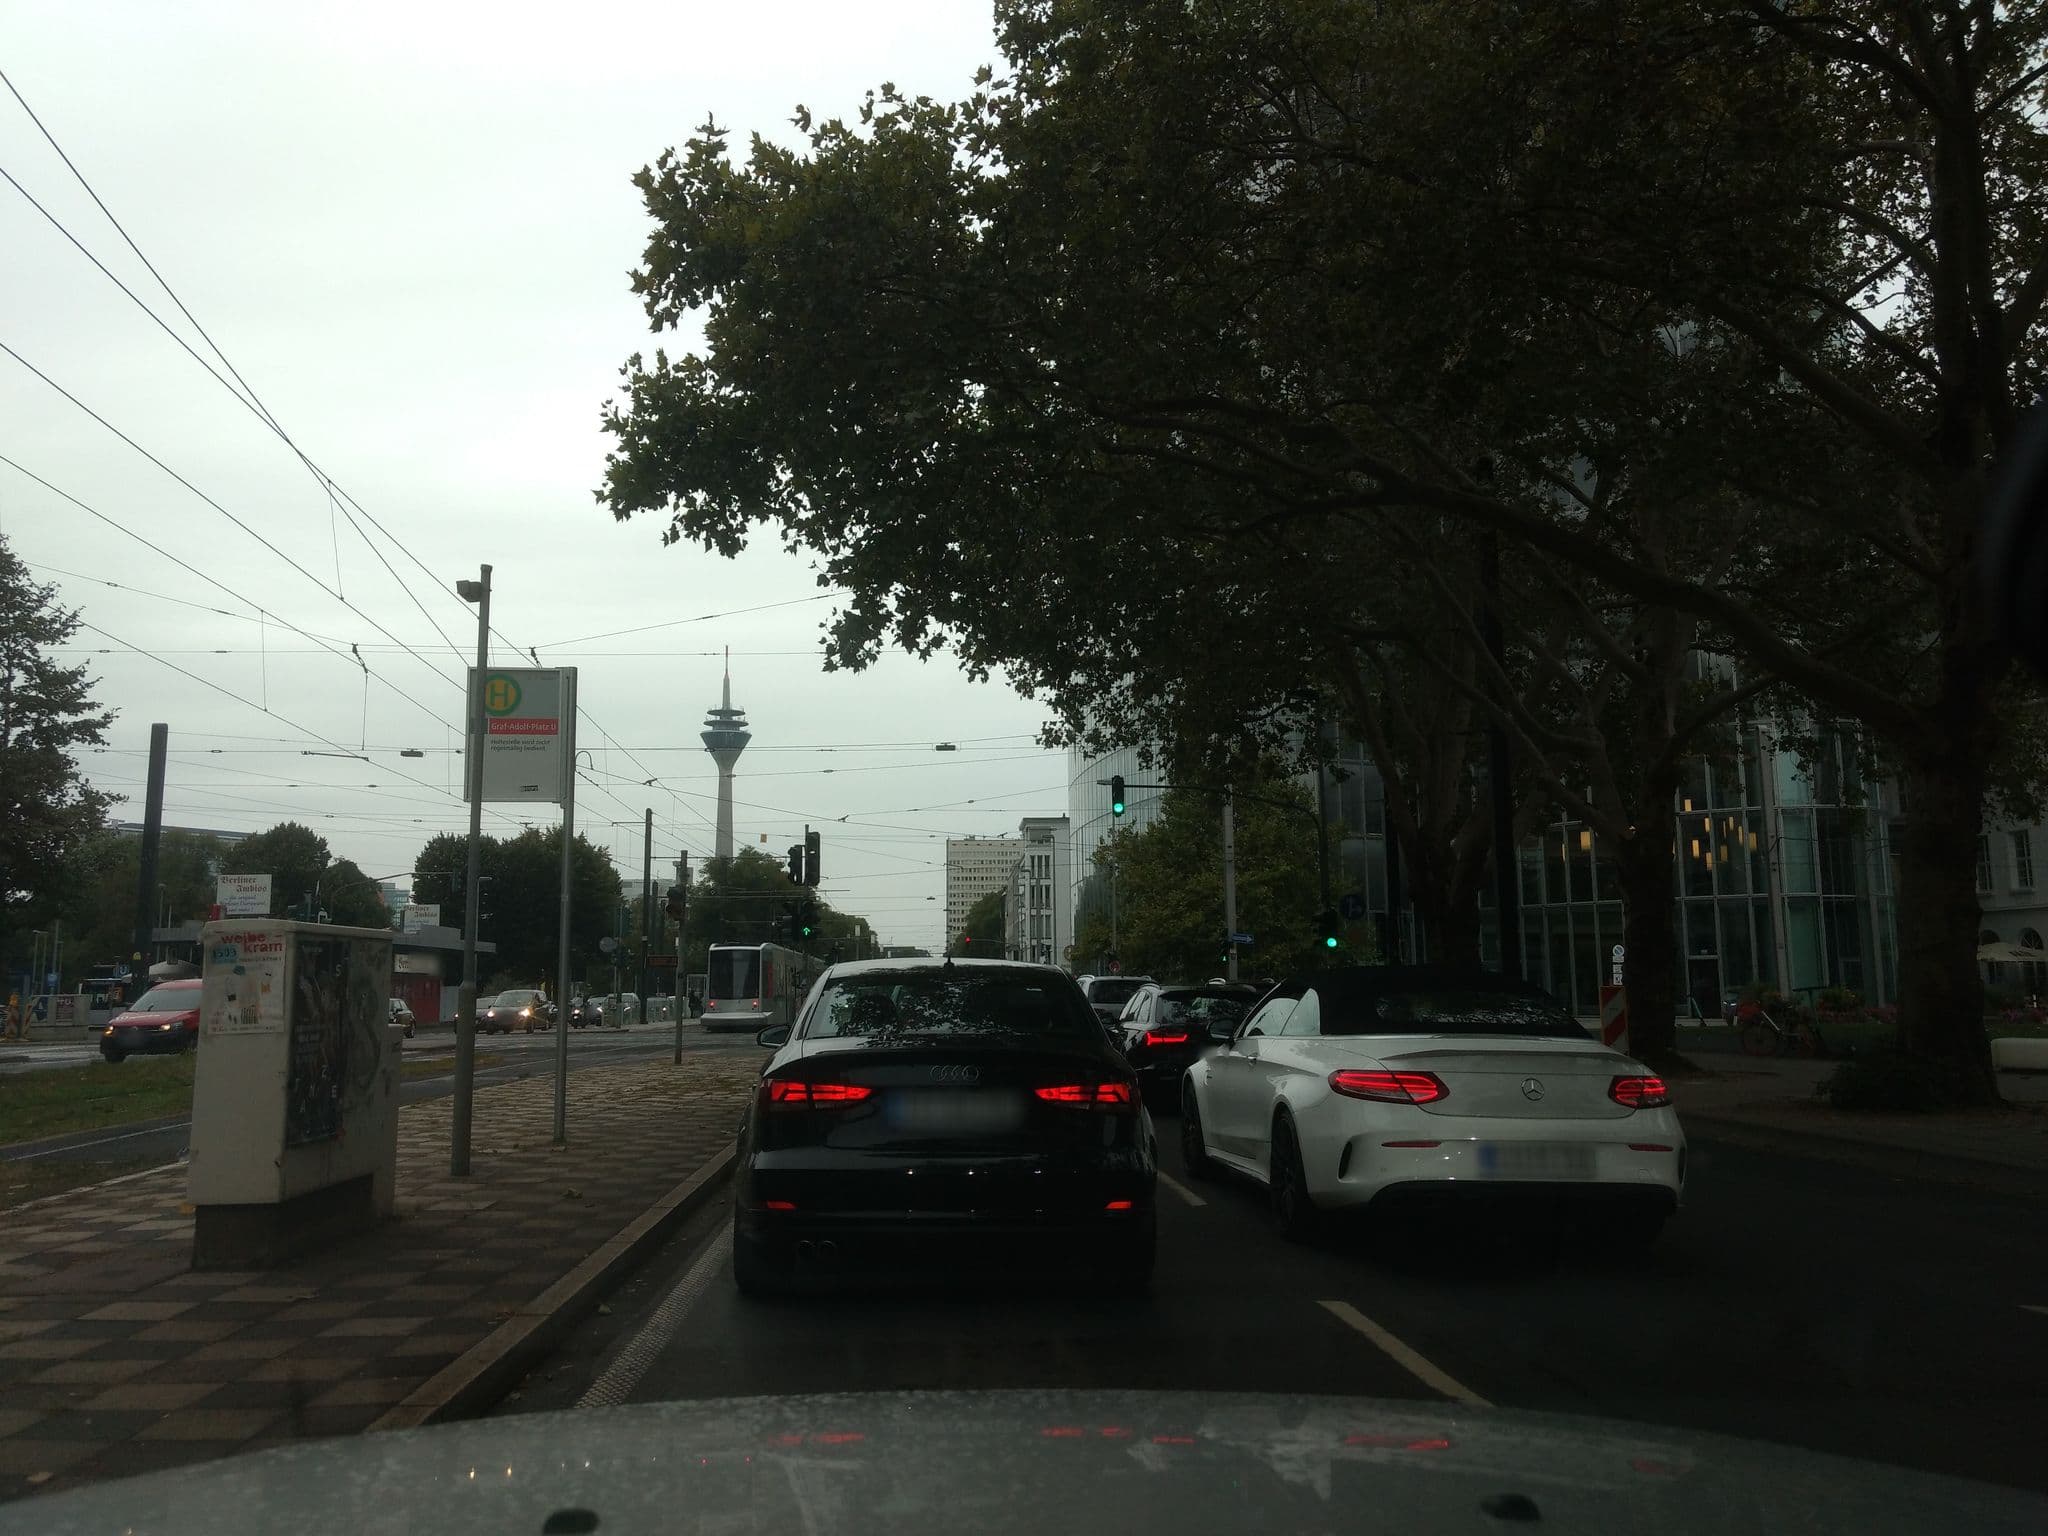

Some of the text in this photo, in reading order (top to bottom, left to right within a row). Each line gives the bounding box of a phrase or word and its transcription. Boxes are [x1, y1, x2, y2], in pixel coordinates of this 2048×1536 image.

[490, 683, 509, 706] H
[491, 722, 549, 731] Graf-Adolf-Platz
[221, 876, 256, 885] Berliner
